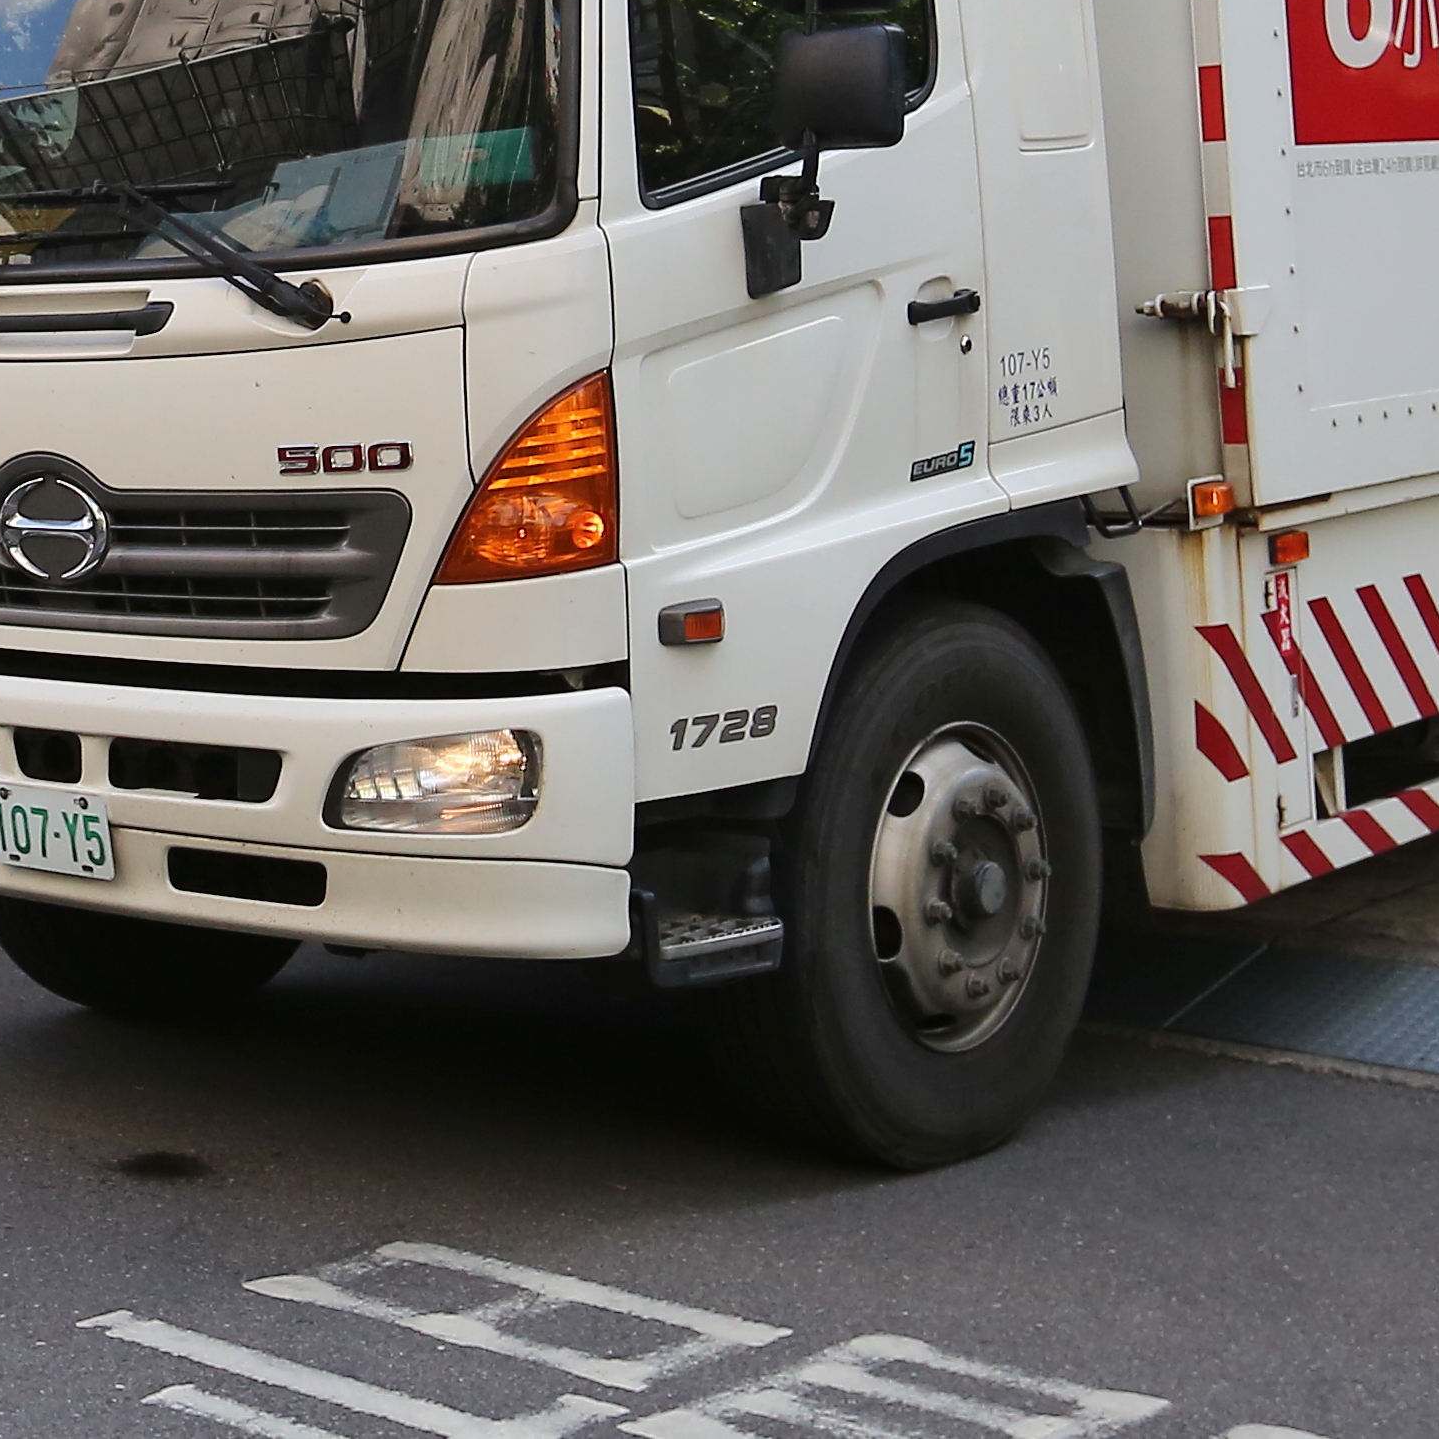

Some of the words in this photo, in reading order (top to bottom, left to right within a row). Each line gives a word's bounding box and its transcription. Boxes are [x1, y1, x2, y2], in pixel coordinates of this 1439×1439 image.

[1000, 348, 1051, 377] 107-Y5
[275, 440, 414, 475] 500
[670, 705, 778, 751] 1728
